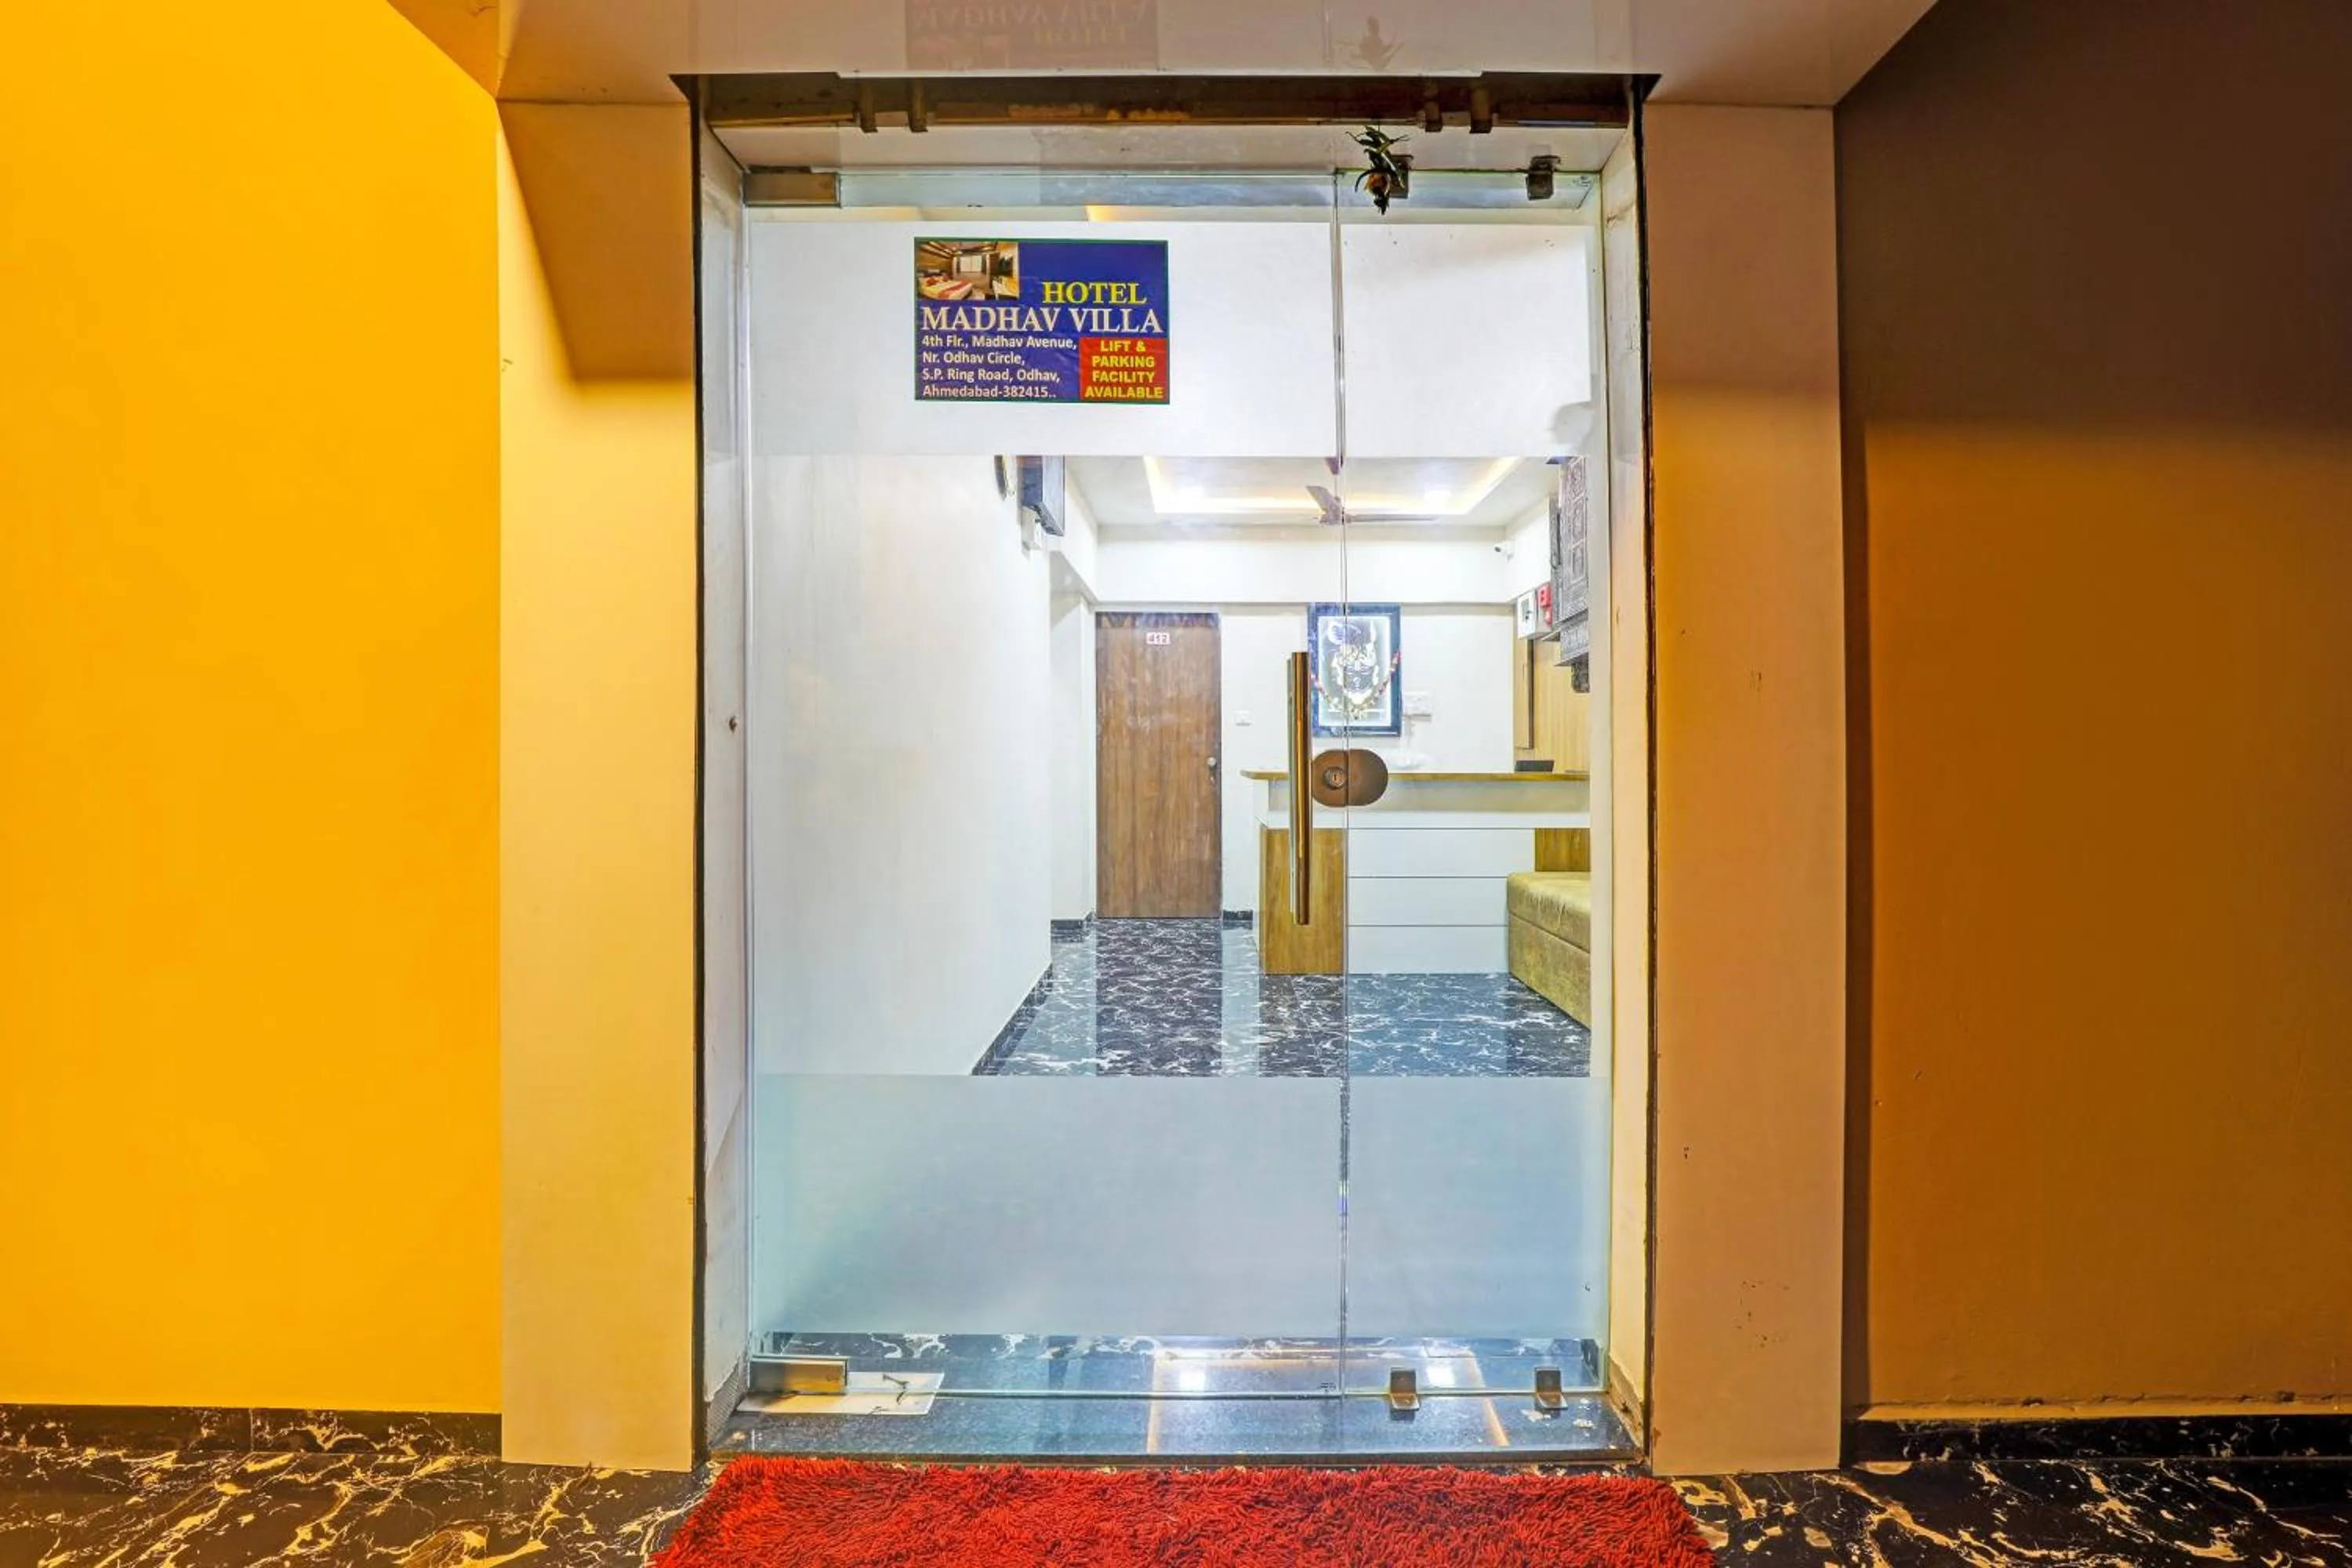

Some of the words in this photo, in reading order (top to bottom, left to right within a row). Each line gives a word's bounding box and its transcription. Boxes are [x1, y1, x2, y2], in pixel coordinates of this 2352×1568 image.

[1042, 281, 1146, 303] HOTEL
[920, 307, 1061, 332] MADHAV
[1068, 308, 1163, 333] VILLA
[922, 335, 943, 347] 4th
[972, 335, 1023, 347] Madhav
[1026, 336, 1076, 350] Avenue,
[1100, 339, 1131, 352] LIFT
[1136, 339, 1146, 352] &
[923, 350, 940, 363] Nr.
[943, 351, 984, 363] Odhav
[988, 351, 1025, 366] Circle,
[1091, 355, 1155, 368] PARKING
[923, 368, 943, 380] S.P.
[947, 368, 975, 383] Ring
[978, 368, 1014, 383] Road,
[1017, 368, 1060, 383] Odhav,
[1092, 370, 1155, 383] FACILITY
[1084, 386, 1164, 399] AVAILABLE
